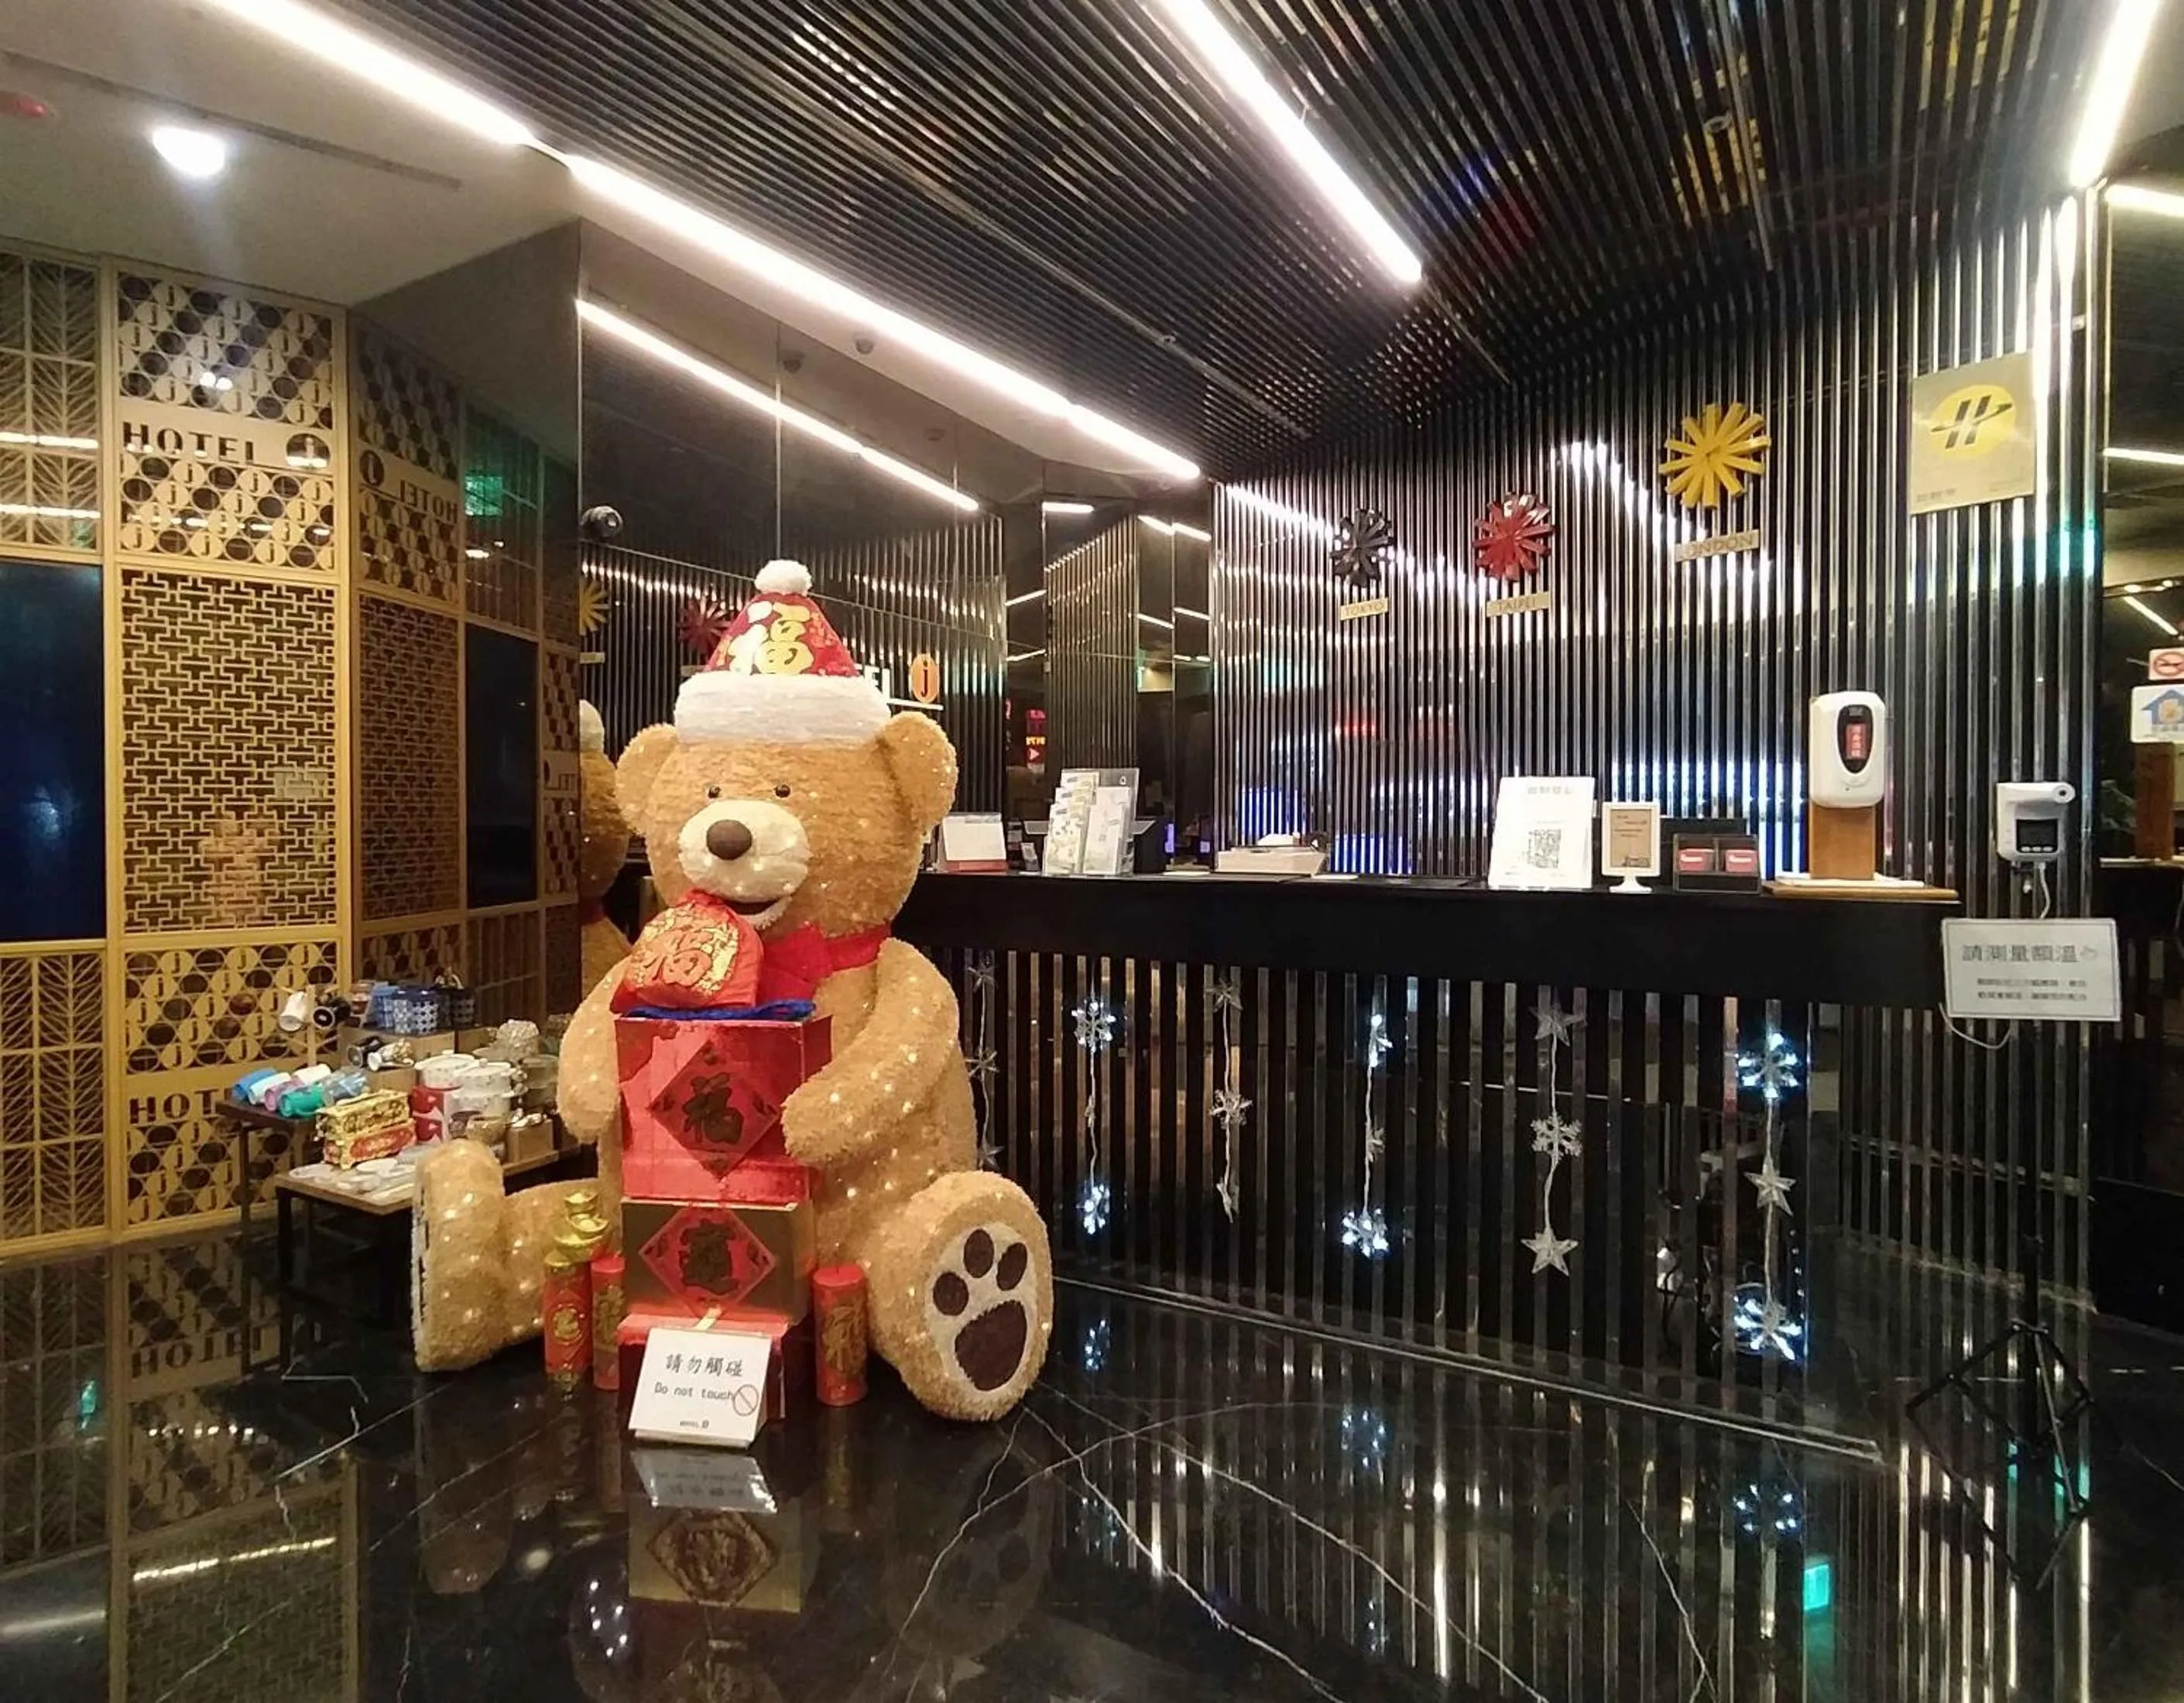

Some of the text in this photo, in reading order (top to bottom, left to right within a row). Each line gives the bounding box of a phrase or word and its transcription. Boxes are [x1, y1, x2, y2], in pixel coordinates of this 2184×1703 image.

[122, 421, 256, 466] HOTEL
[728, 601, 814, 675] 福
[641, 928, 714, 988] 福
[129, 1088, 232, 1124] HOT
[682, 1071, 744, 1146] 福
[665, 1354, 743, 1377] 請勿觸碰
[654, 1382, 734, 1400] Do not touch
